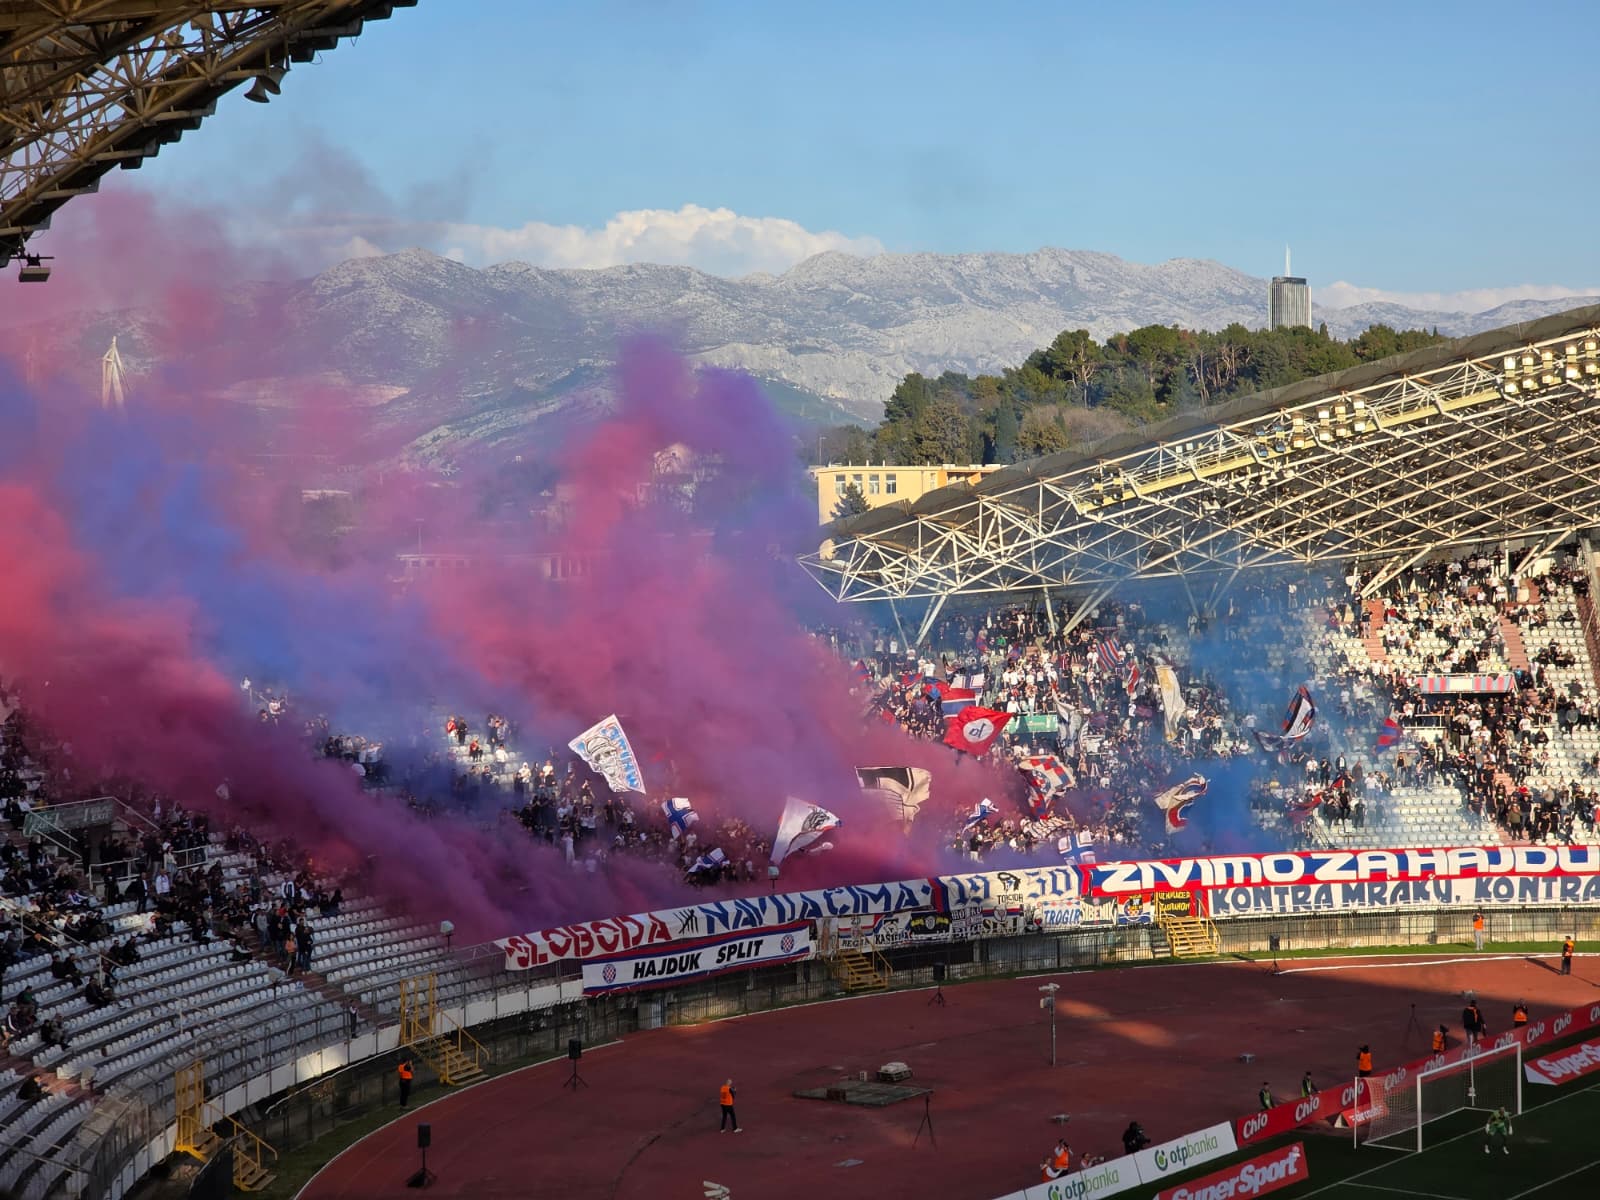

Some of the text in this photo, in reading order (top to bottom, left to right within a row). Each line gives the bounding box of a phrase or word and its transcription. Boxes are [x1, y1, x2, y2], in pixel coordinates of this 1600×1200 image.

[1311, 851, 1398, 881] ZA
[1210, 883, 1334, 914] KONTRA
[1475, 876, 1600, 903] KONTRA
[633, 939, 763, 979] HAJDUK SPLIT
[1527, 1021, 1545, 1043] Chio
[1554, 1012, 1572, 1034] Chio
[1384, 1067, 1407, 1091] Chio
[1295, 1095, 1319, 1122] Chio
[1243, 1112, 1268, 1139] Chio
